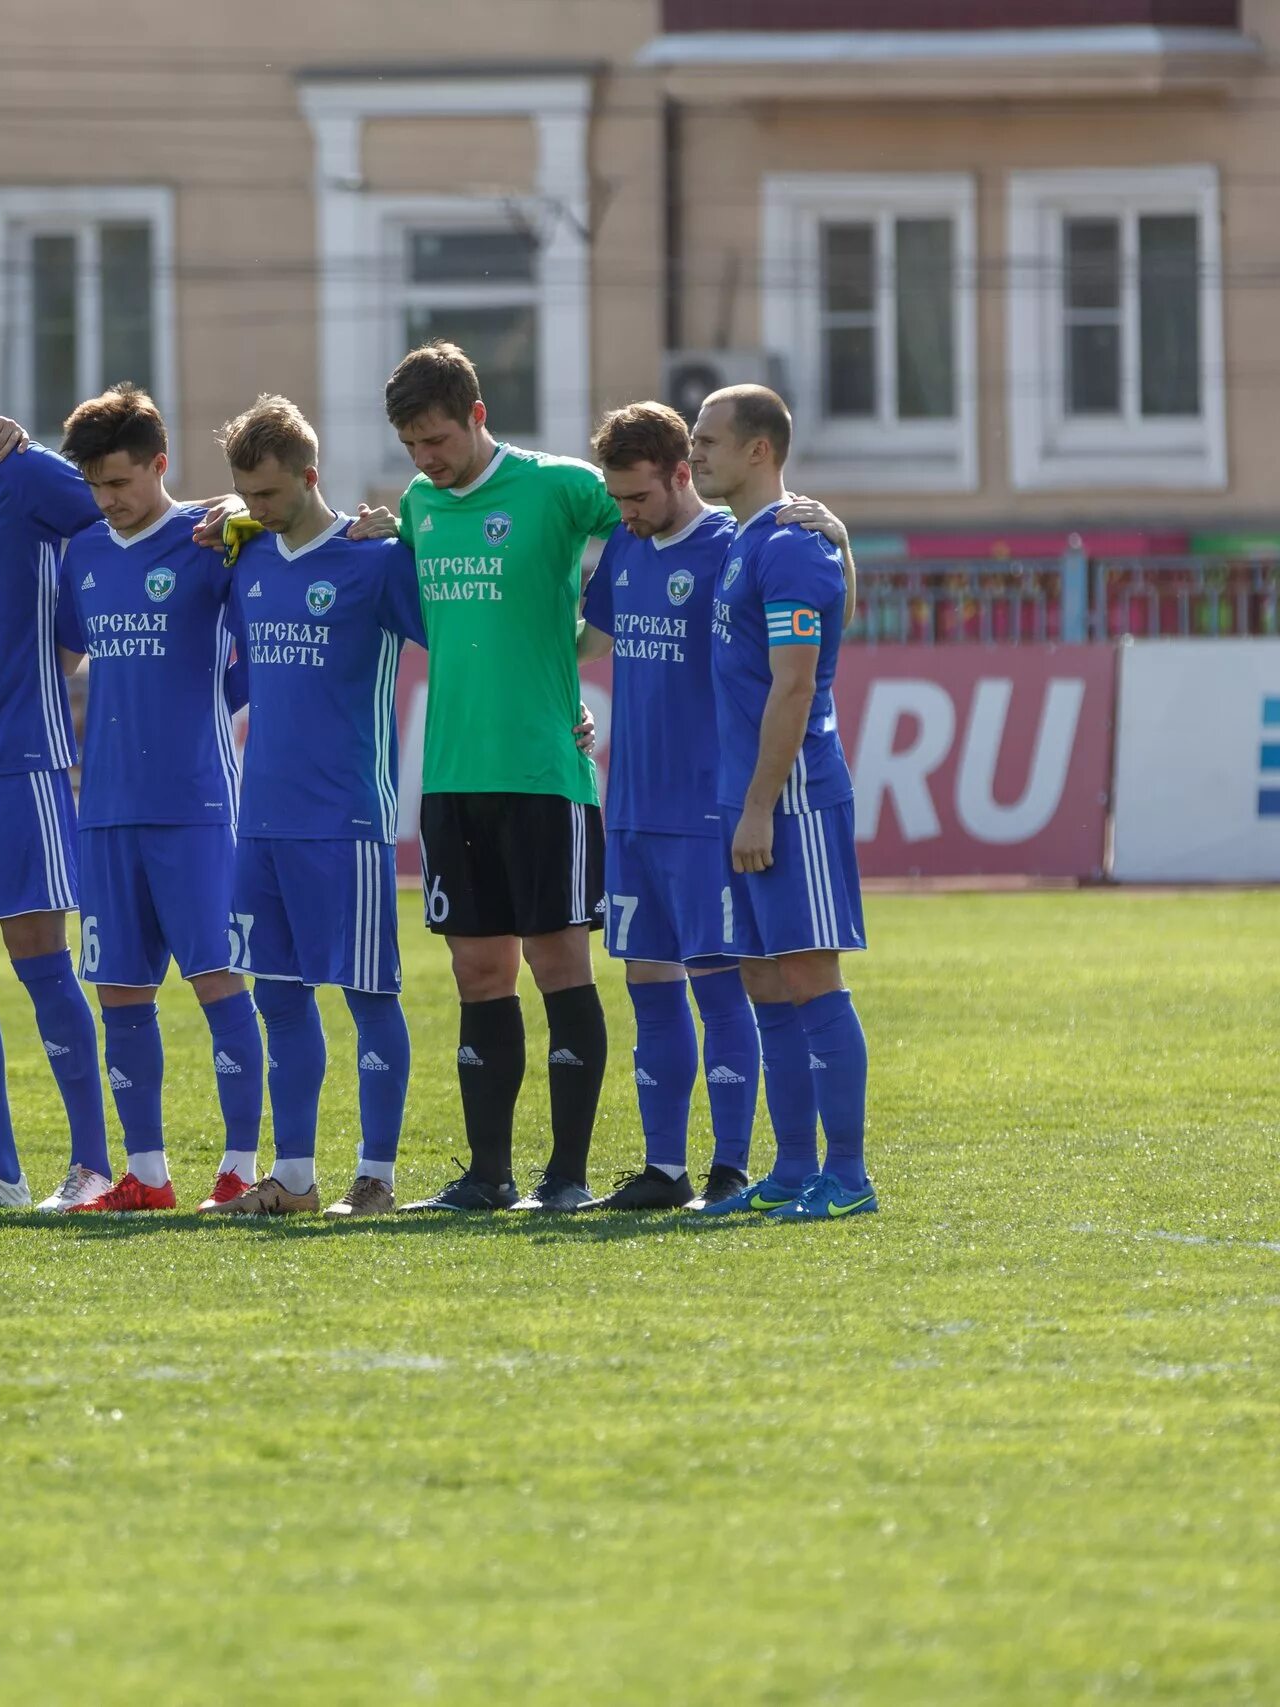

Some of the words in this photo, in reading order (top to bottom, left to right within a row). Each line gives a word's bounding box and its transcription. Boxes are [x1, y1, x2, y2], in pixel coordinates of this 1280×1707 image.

[419, 557, 504, 581] КУРСКАЯ
[423, 581, 503, 602] ОБЛАСТЬ
[248, 622, 330, 646] КУРСКАЯ
[613, 613, 688, 638] КУРСКАЯ
[429, 875, 450, 923] 6
[82, 915, 101, 973] 6
